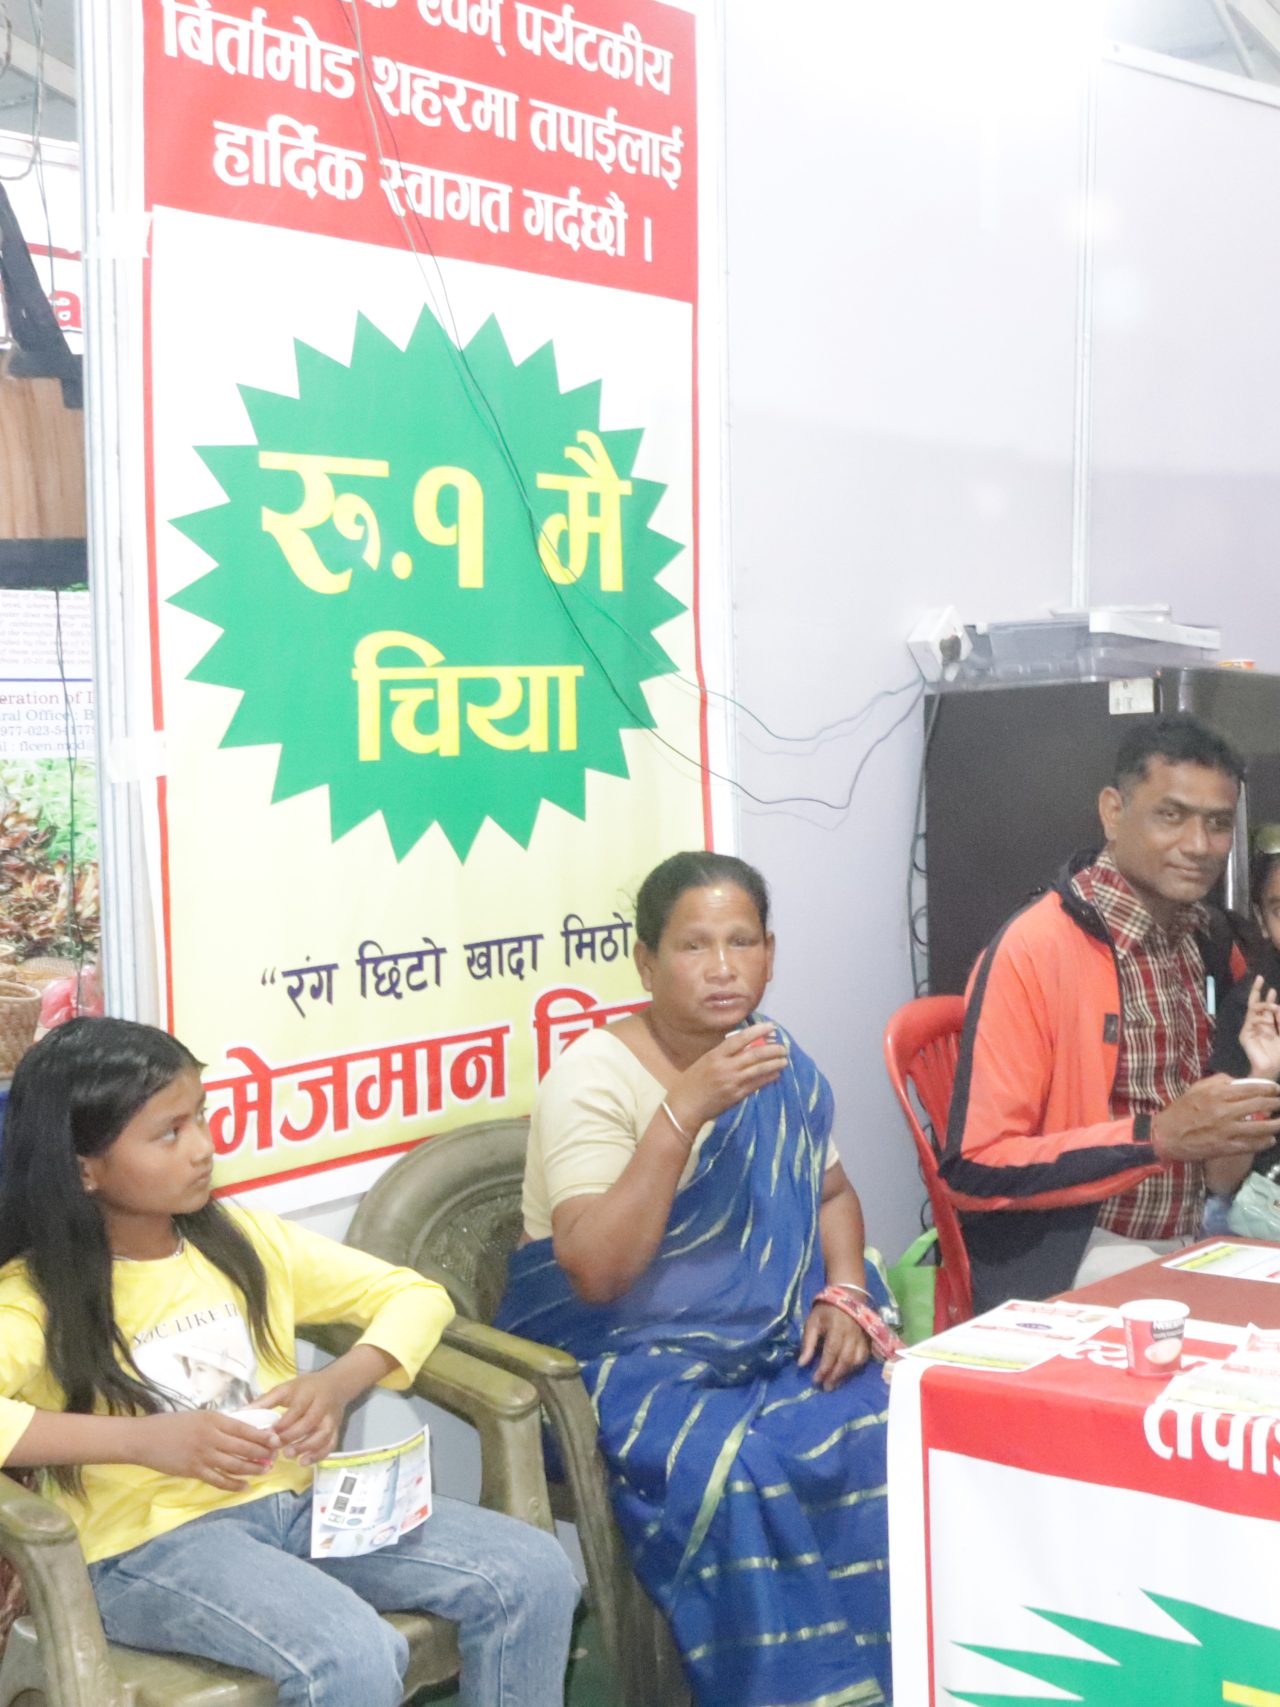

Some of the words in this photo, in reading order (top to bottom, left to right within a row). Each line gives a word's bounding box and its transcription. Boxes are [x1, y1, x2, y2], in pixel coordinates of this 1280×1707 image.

[162, 0, 360, 99] बिर्तामोड
[371, 55, 519, 141] शहरमा
[529, 98, 684, 190] तपाईलाई
[514, 2, 673, 96] पर्यटकीय
[212, 113, 367, 200] हार्दिक
[379, 157, 512, 234] स्वागत
[352, 629, 585, 762] चिया
[356, 937, 447, 1000] छिटो
[463, 933, 544, 981] खादा
[205, 1025, 510, 1154] मेजमान
[175, 1307, 218, 1332] LIKE
